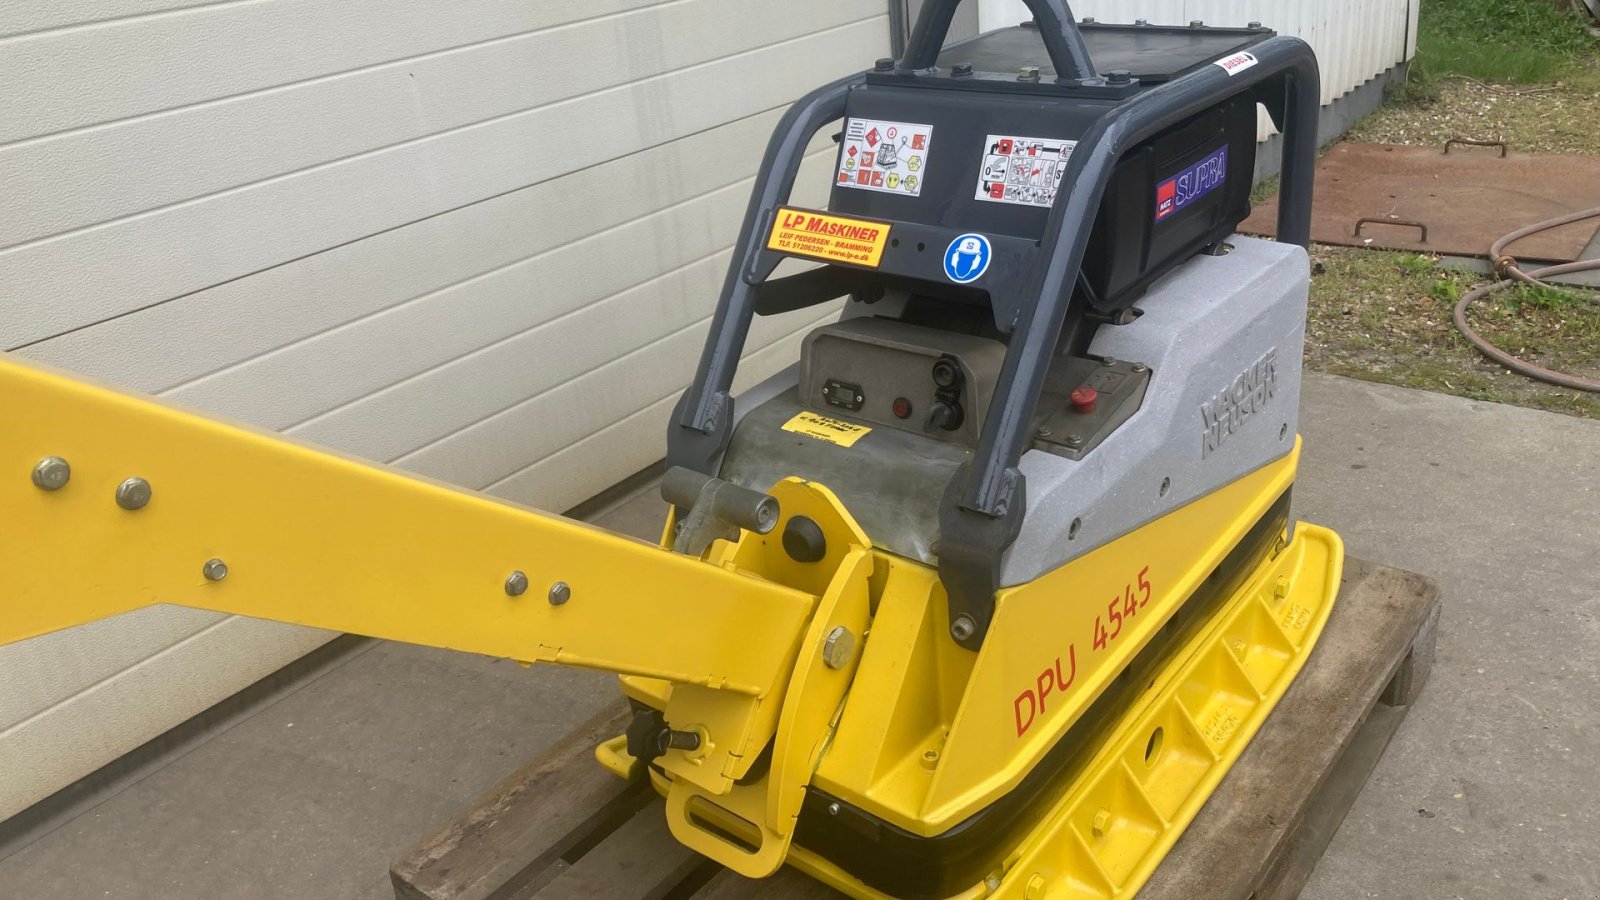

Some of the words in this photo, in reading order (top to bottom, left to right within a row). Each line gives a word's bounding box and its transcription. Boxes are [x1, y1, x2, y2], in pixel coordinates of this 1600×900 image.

[1175, 152, 1225, 206] SUPRA
[783, 213, 805, 228] LP
[805, 217, 879, 242] MASKINER
[794, 234, 831, 246] PEDERSEN
[834, 241, 874, 253] BRAMMING
[1200, 346, 1278, 429] WACKER
[1202, 371, 1278, 460] NEUSON
[1014, 643, 1076, 738] DPU
[1092, 565, 1151, 652] 4545
